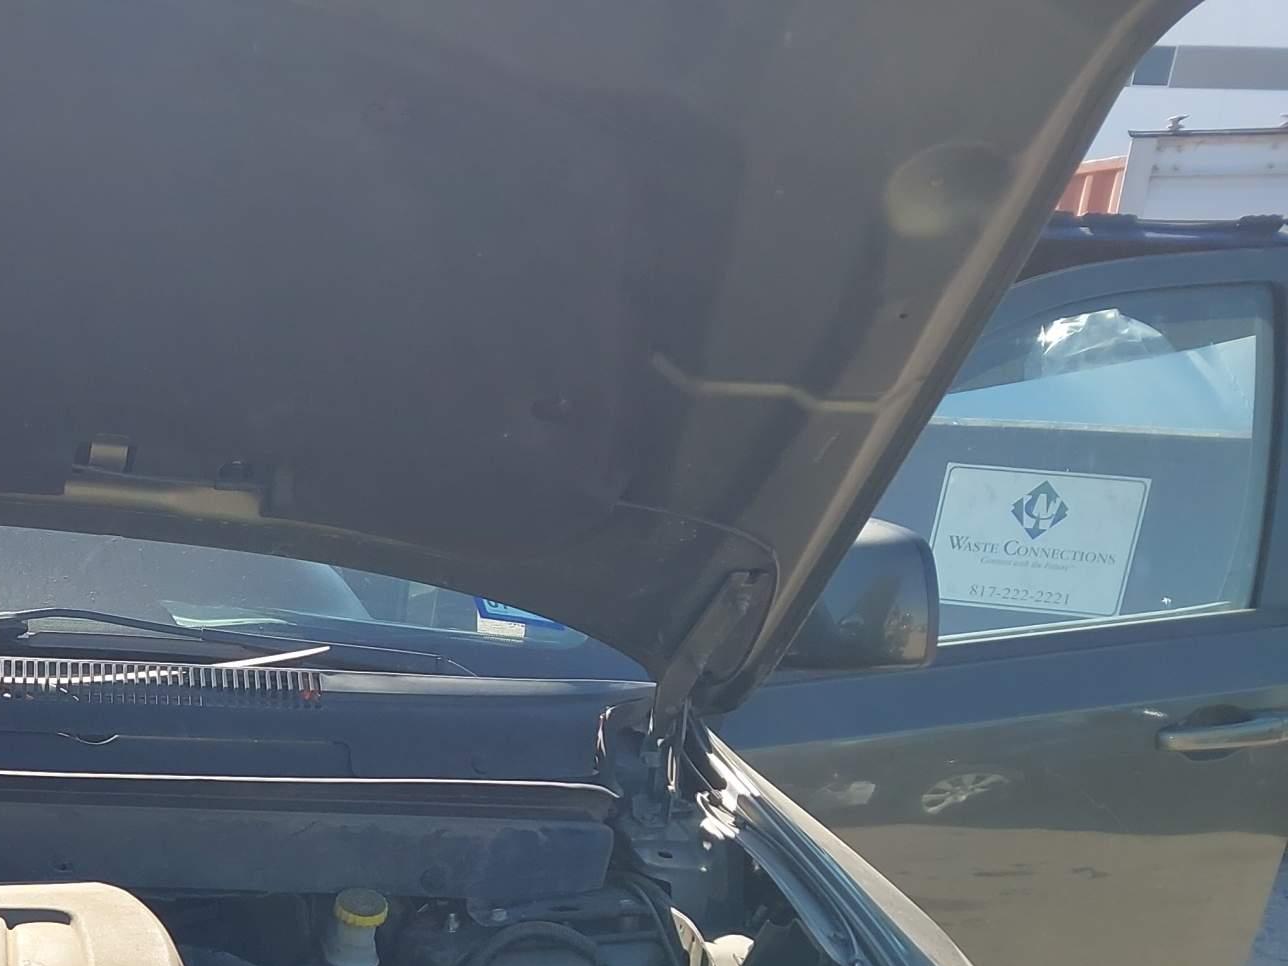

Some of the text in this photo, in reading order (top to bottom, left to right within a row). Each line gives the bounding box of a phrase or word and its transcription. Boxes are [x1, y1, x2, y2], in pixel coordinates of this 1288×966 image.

[949, 535, 1000, 554] WASTE
[1003, 539, 1117, 565] CONNECTIONS
[968, 583, 1071, 606] 817-222-2221
